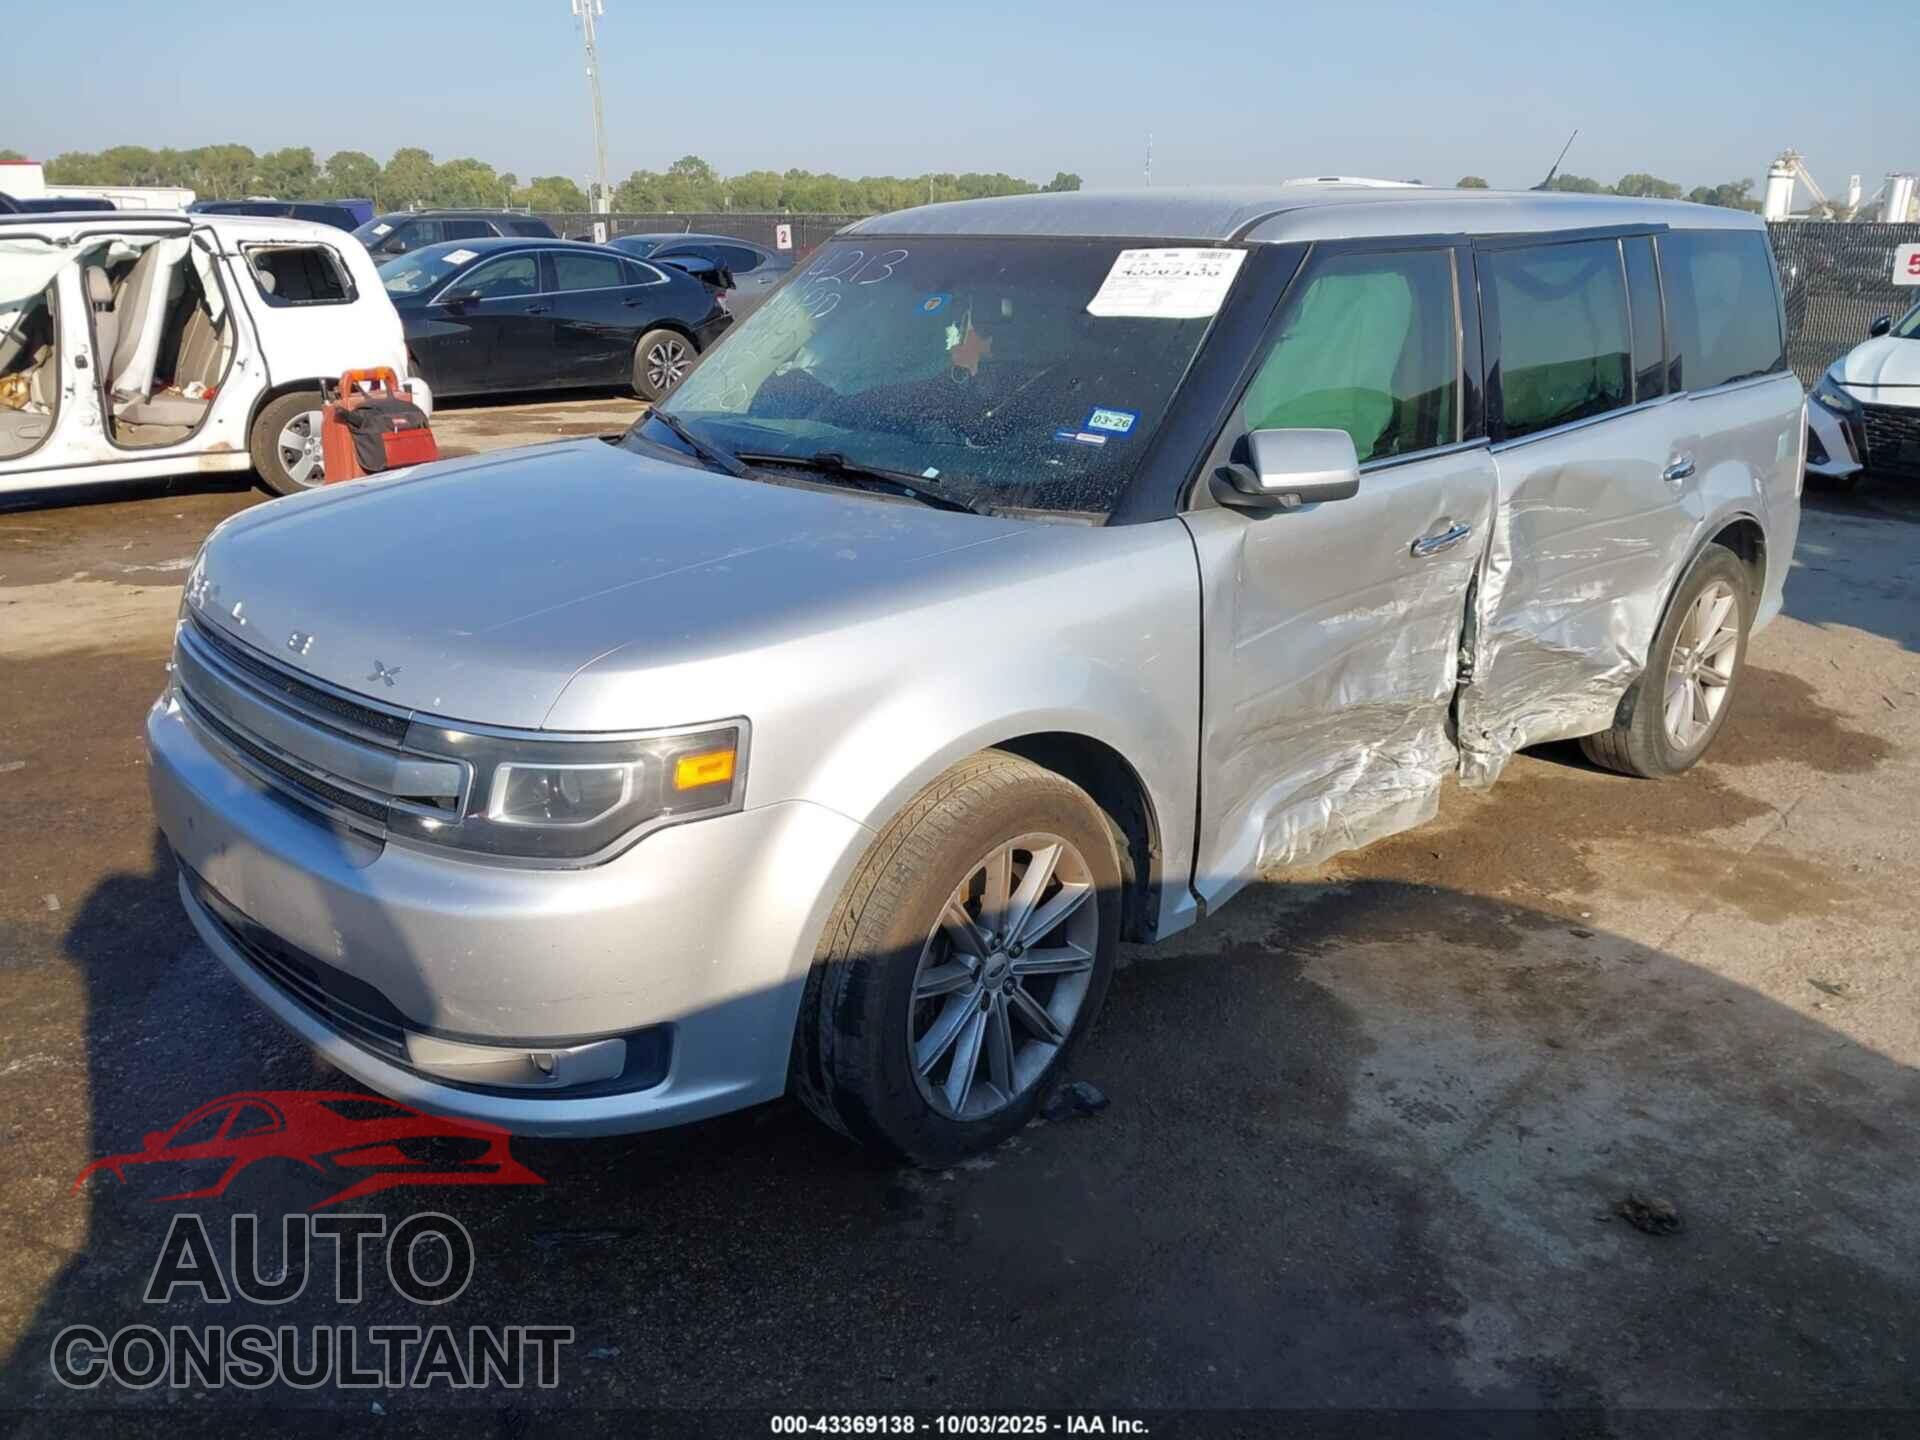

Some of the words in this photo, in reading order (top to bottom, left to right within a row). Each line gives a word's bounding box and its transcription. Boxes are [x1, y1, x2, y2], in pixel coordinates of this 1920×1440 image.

[780, 230, 787, 243] 2
[1908, 254, 1920, 275] 5
[1093, 414, 1130, 429] 03-26
